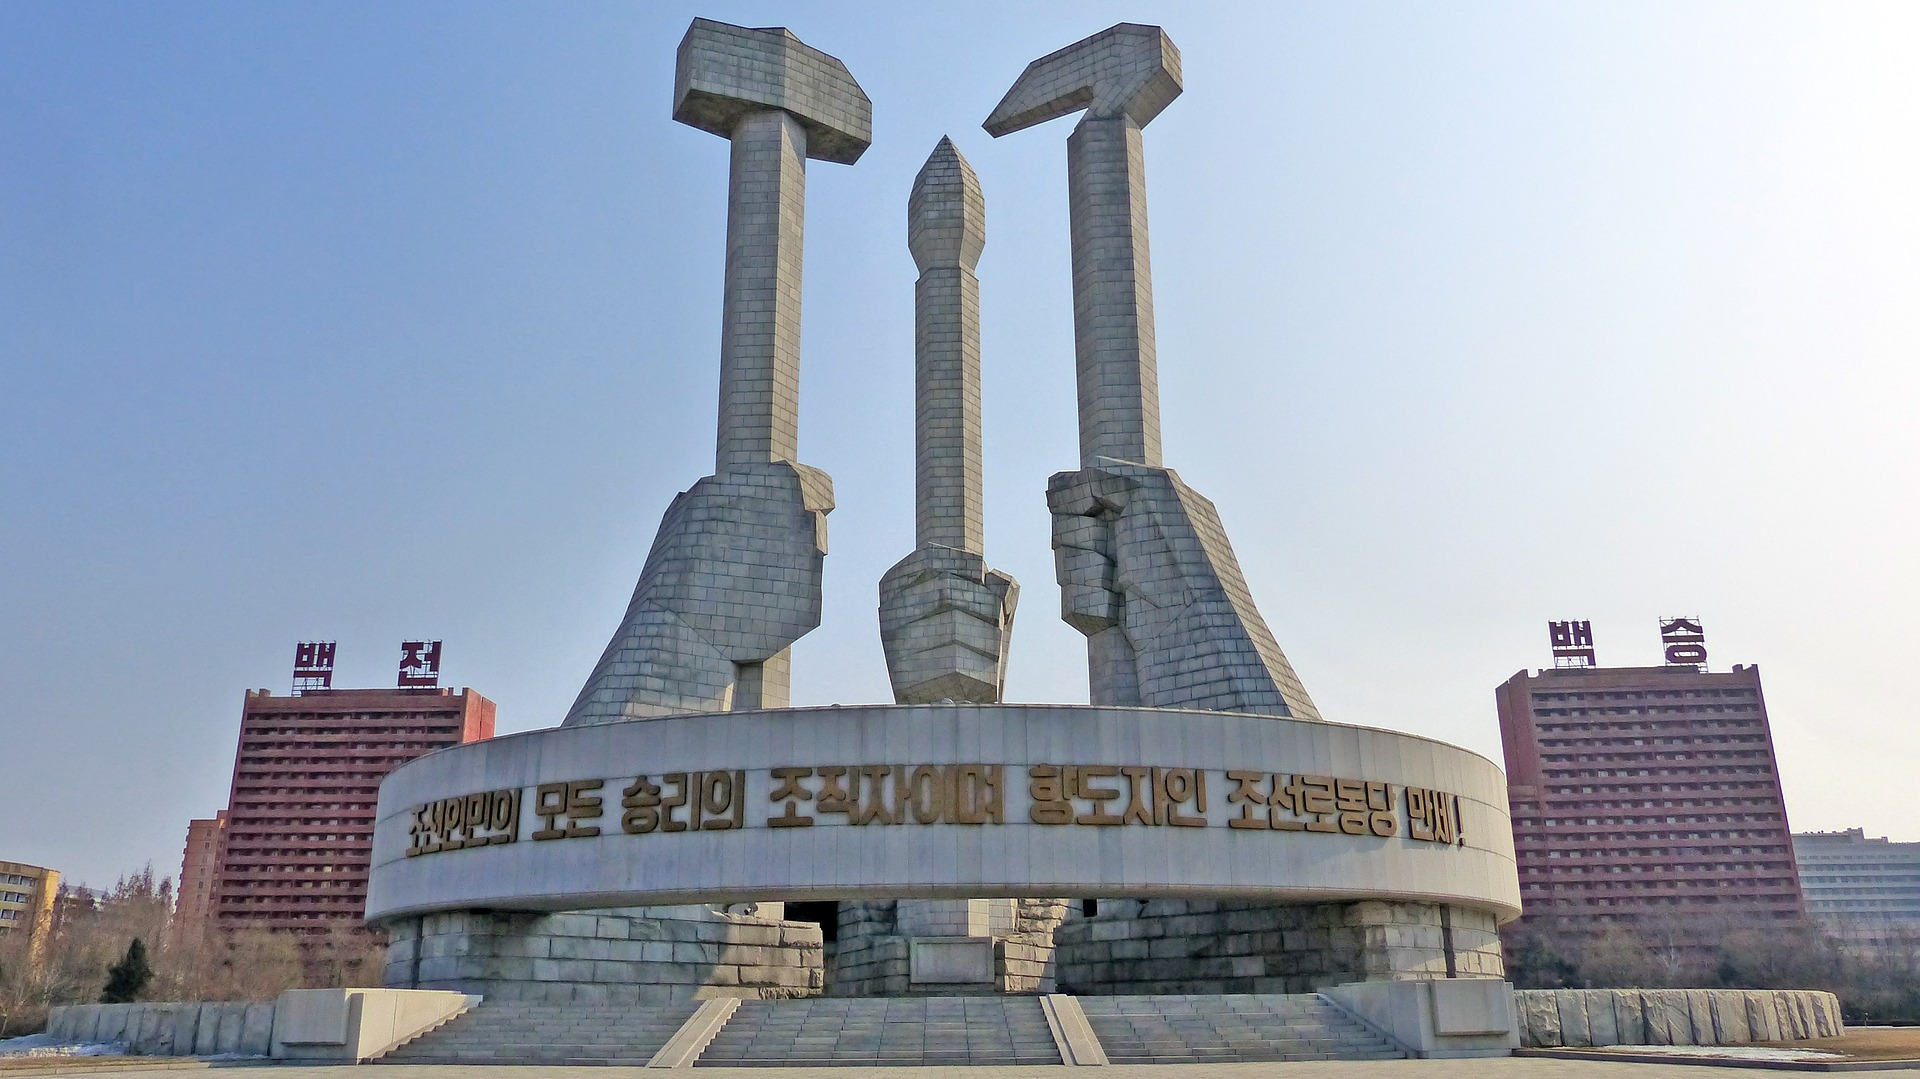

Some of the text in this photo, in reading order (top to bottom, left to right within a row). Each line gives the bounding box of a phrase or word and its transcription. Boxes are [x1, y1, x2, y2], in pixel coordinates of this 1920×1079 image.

[405, 763, 1467, 859] 조선인민의 모든 승리의 조직자이며 향도자인 조선로동당 만세!
